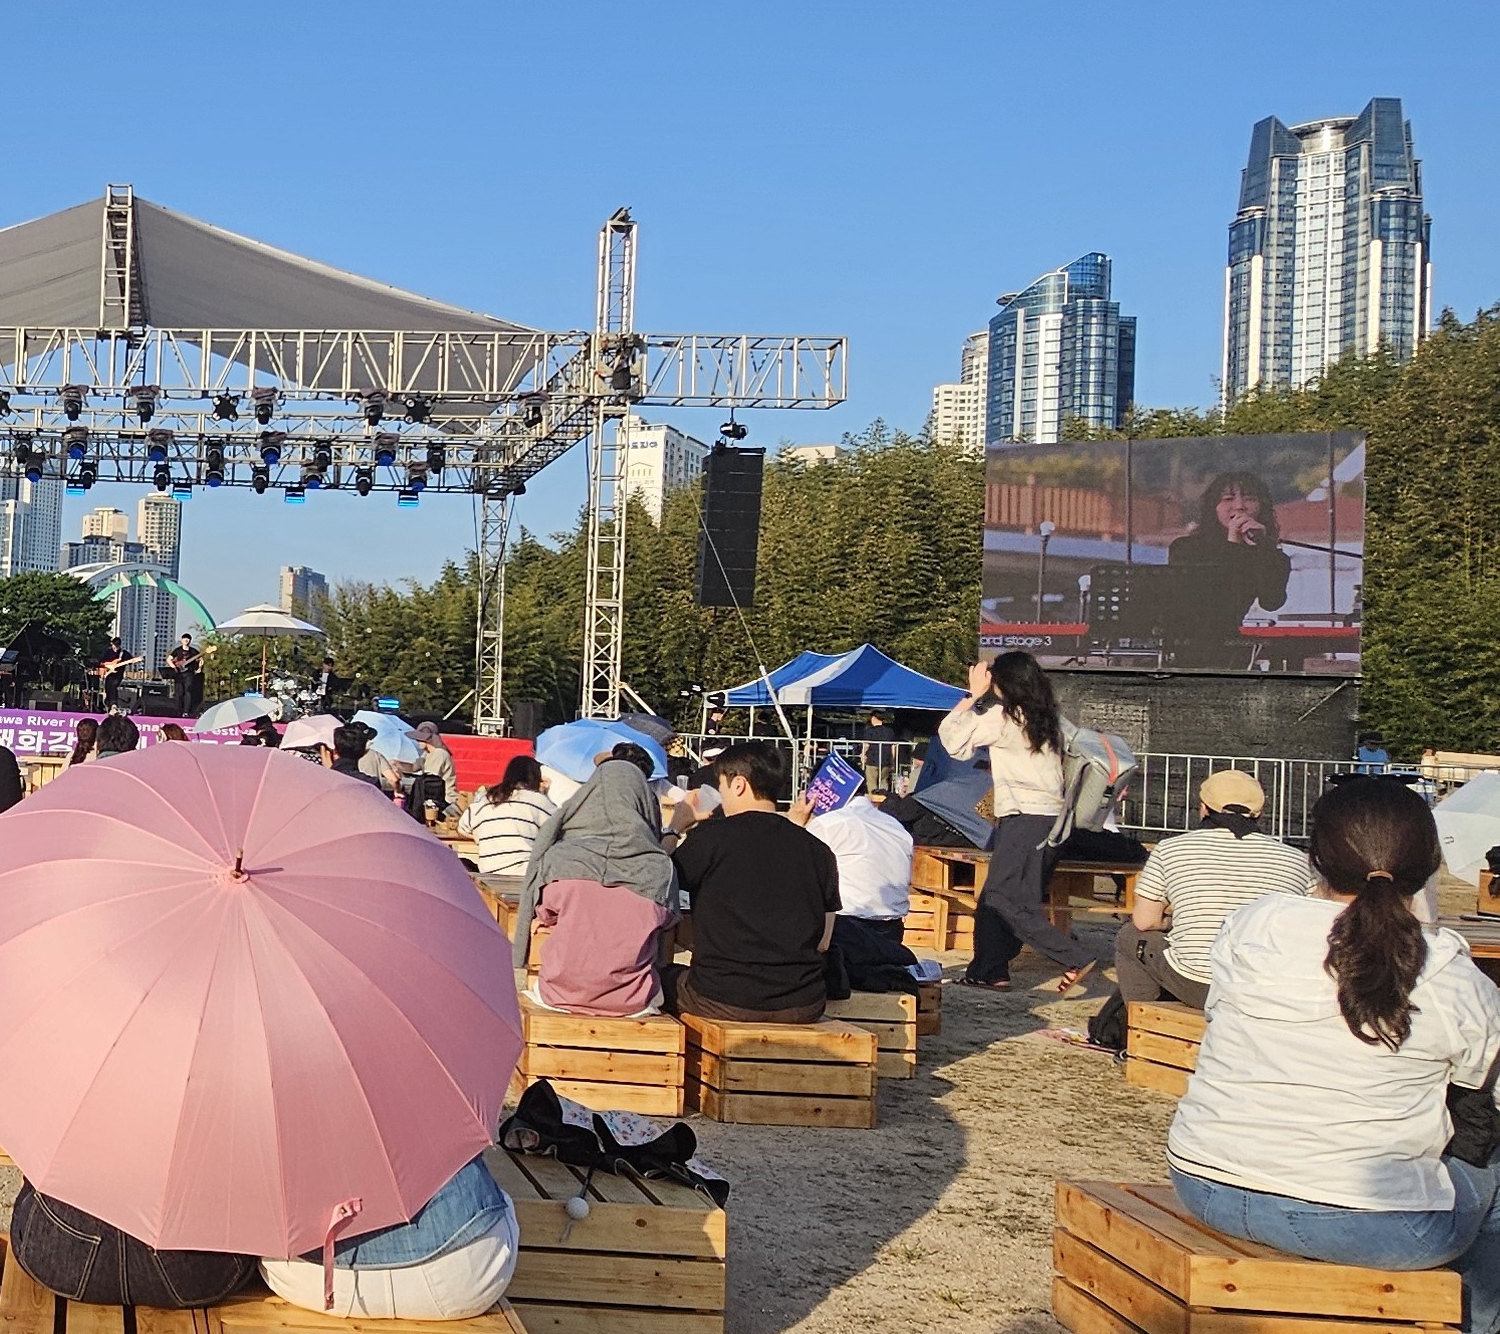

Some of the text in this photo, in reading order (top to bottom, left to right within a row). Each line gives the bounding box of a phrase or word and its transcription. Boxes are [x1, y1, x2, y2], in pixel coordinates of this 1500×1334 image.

[1005, 635, 1043, 648] stage
[1044, 635, 1052, 646] 3
[27, 715, 66, 727] River
